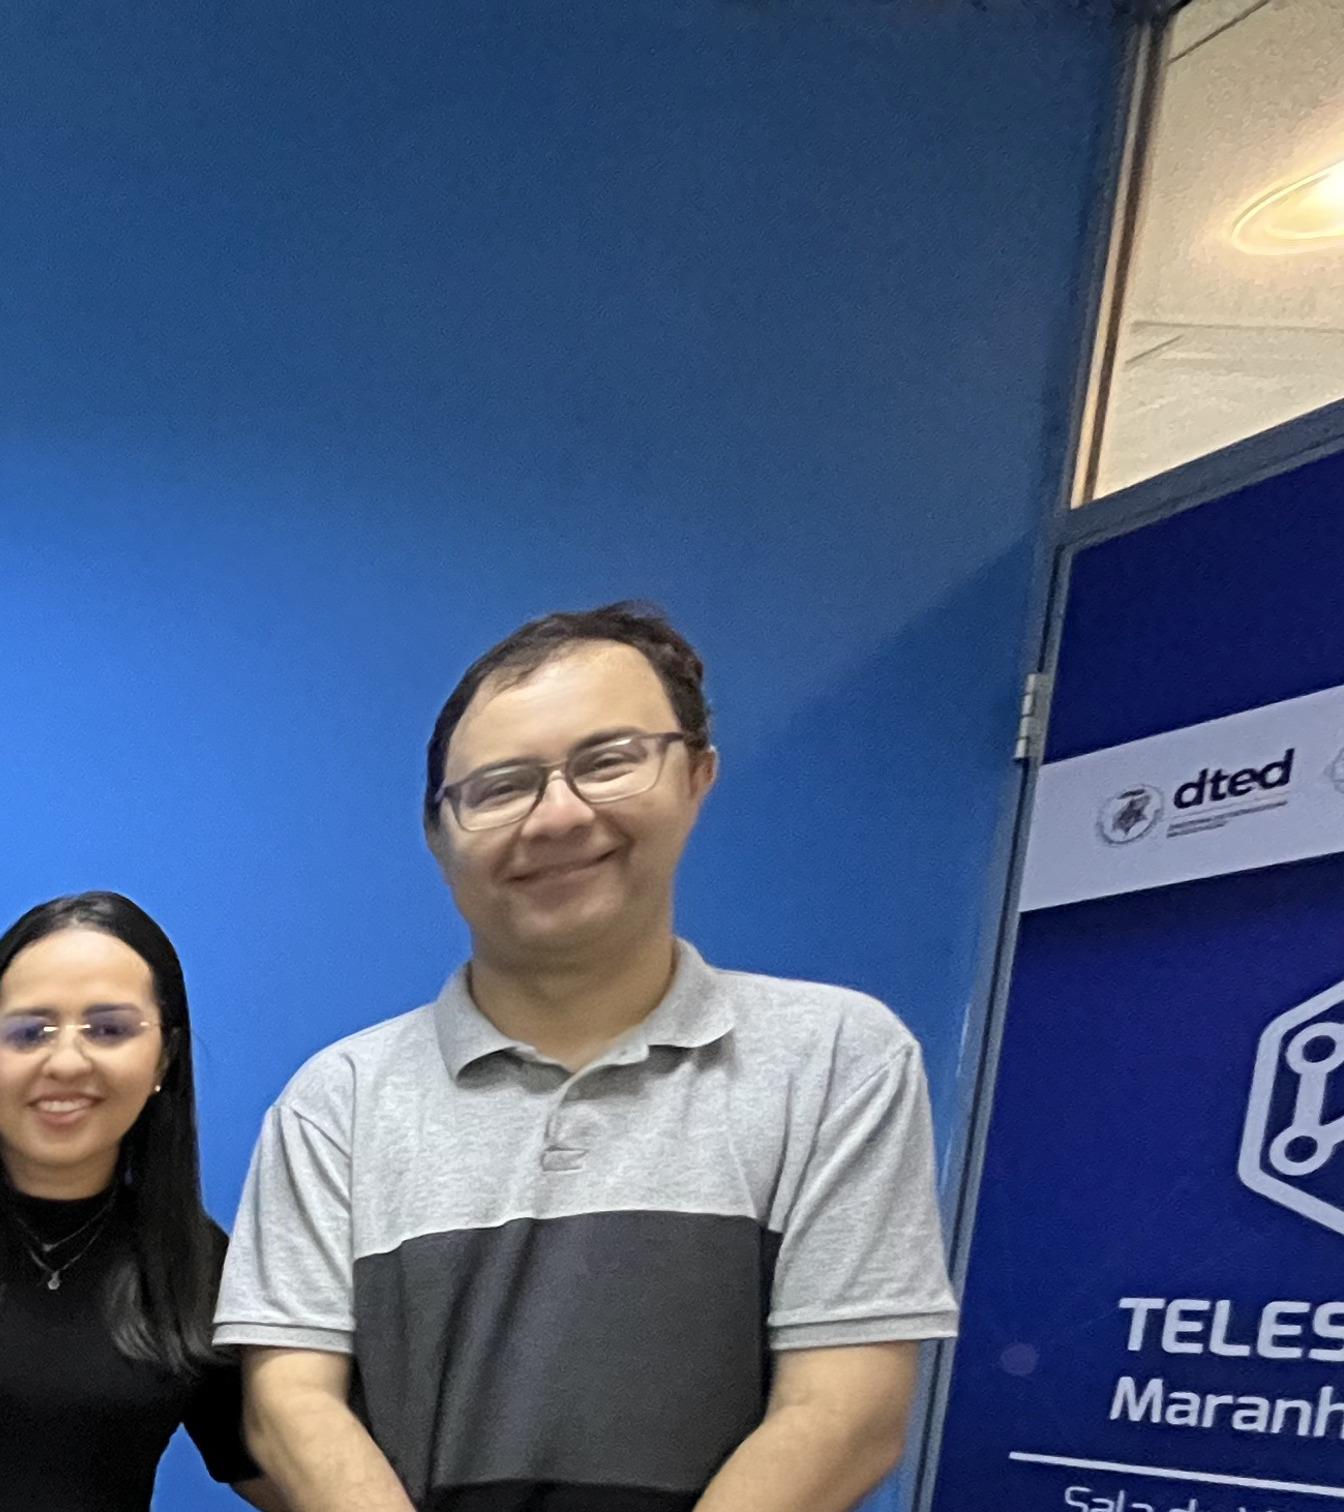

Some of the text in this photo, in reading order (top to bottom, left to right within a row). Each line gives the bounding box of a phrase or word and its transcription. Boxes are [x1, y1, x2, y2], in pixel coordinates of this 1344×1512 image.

[1173, 748, 1296, 809] dted
[1118, 1297, 1344, 1362] TELES
[1109, 1376, 1344, 1439] Maranh
